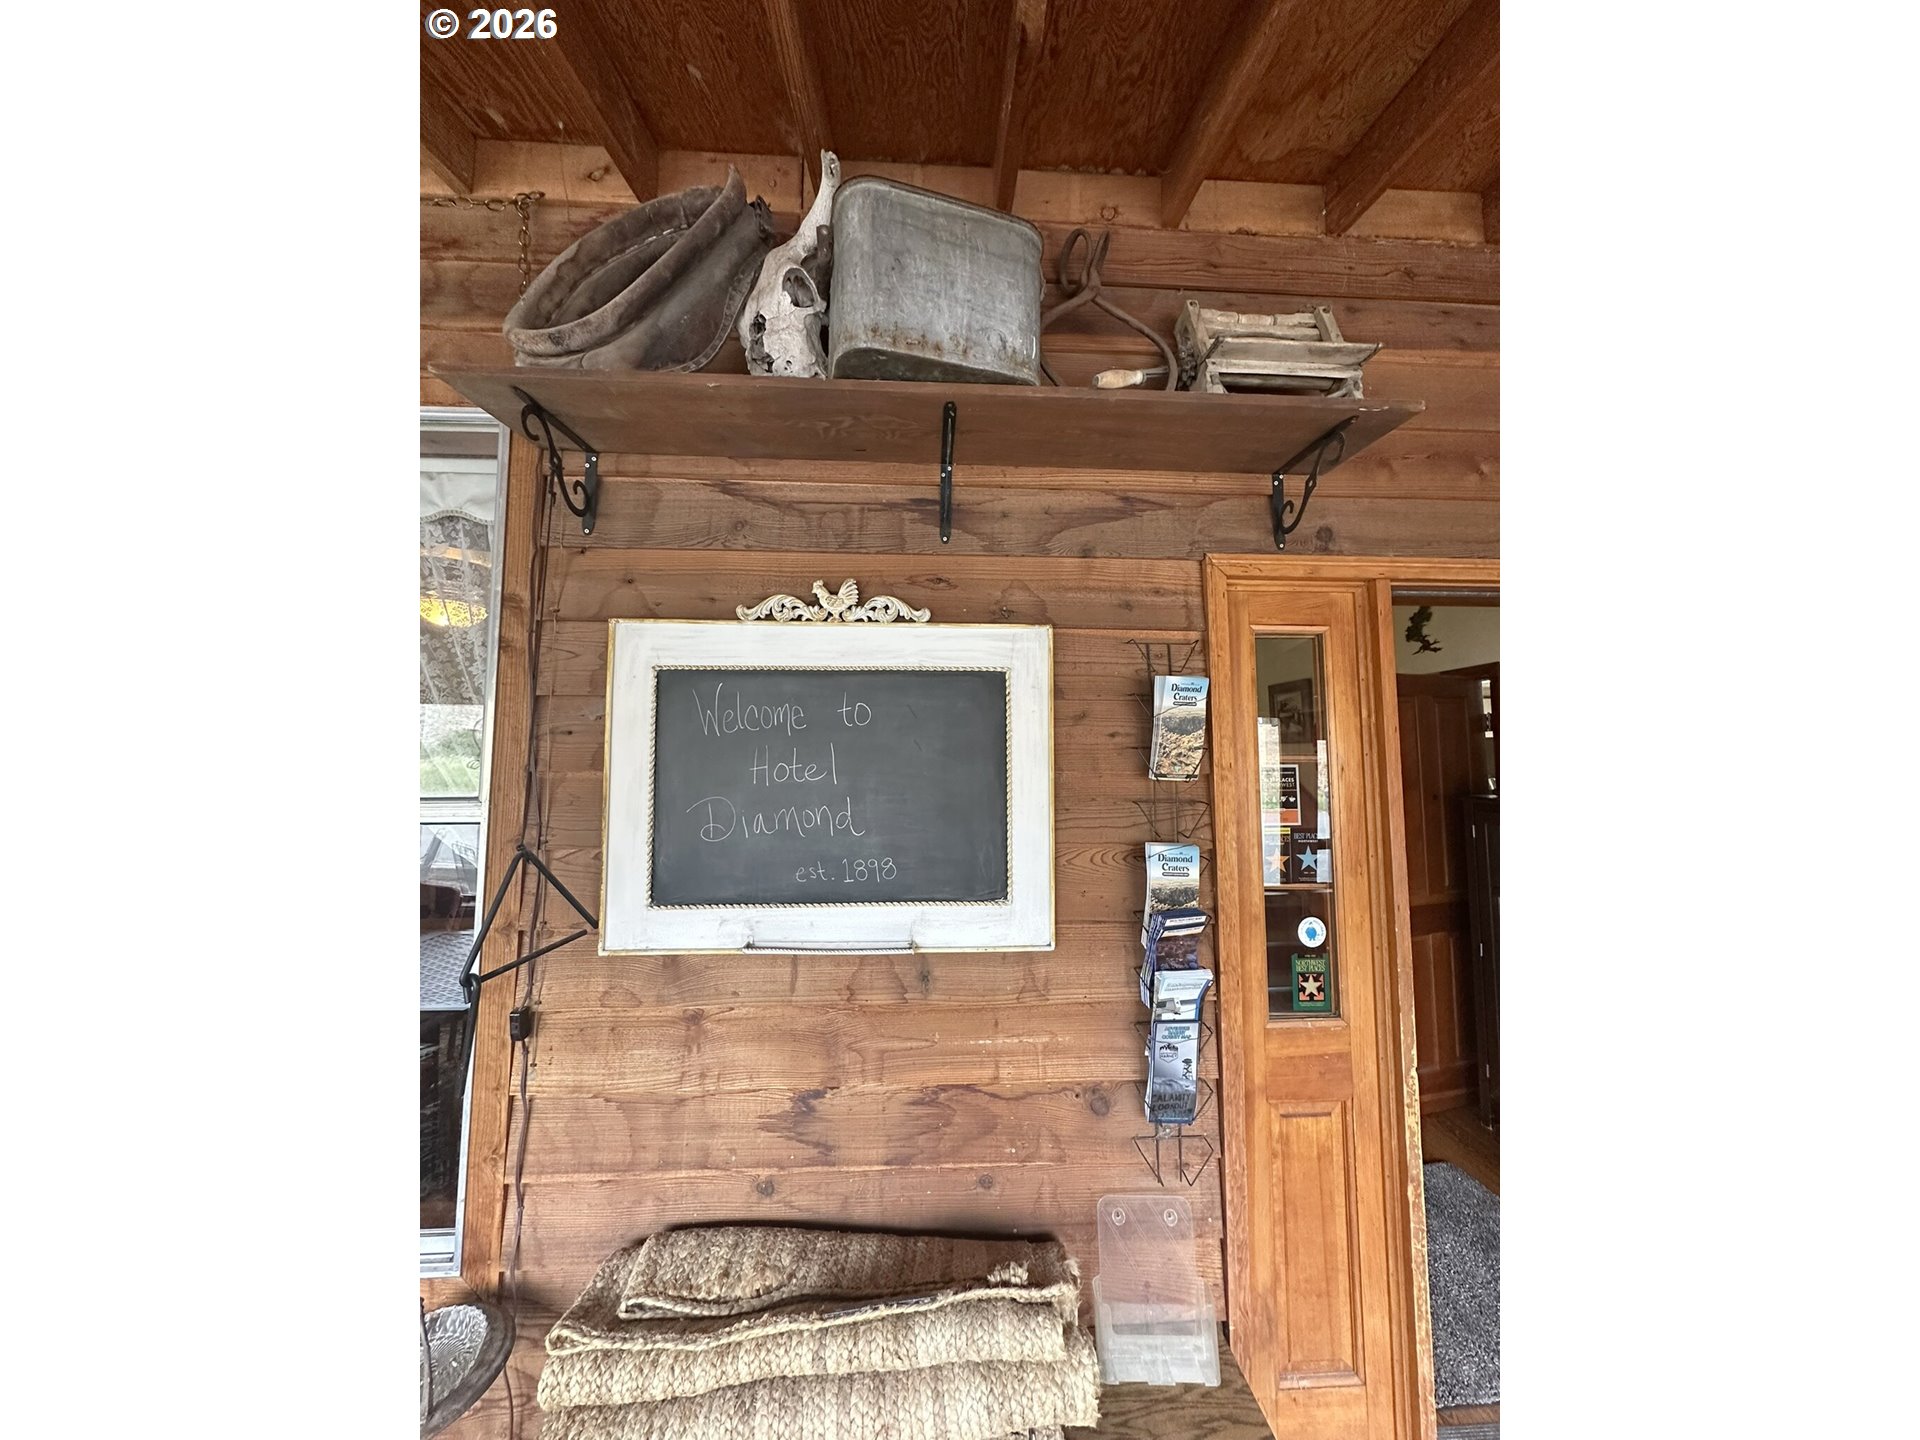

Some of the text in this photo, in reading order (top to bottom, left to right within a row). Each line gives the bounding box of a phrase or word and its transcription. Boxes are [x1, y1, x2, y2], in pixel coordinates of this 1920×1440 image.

[1171, 683, 1203, 693] Diamond
[1173, 692, 1197, 702] Craters
[692, 683, 872, 737] Welcome to
[750, 743, 838, 787] Hotel
[686, 796, 866, 842] Diamond
[1158, 853, 1193, 863] Diamond
[1162, 862, 1190, 872] Craters
[796, 857, 897, 883] est. 1898
